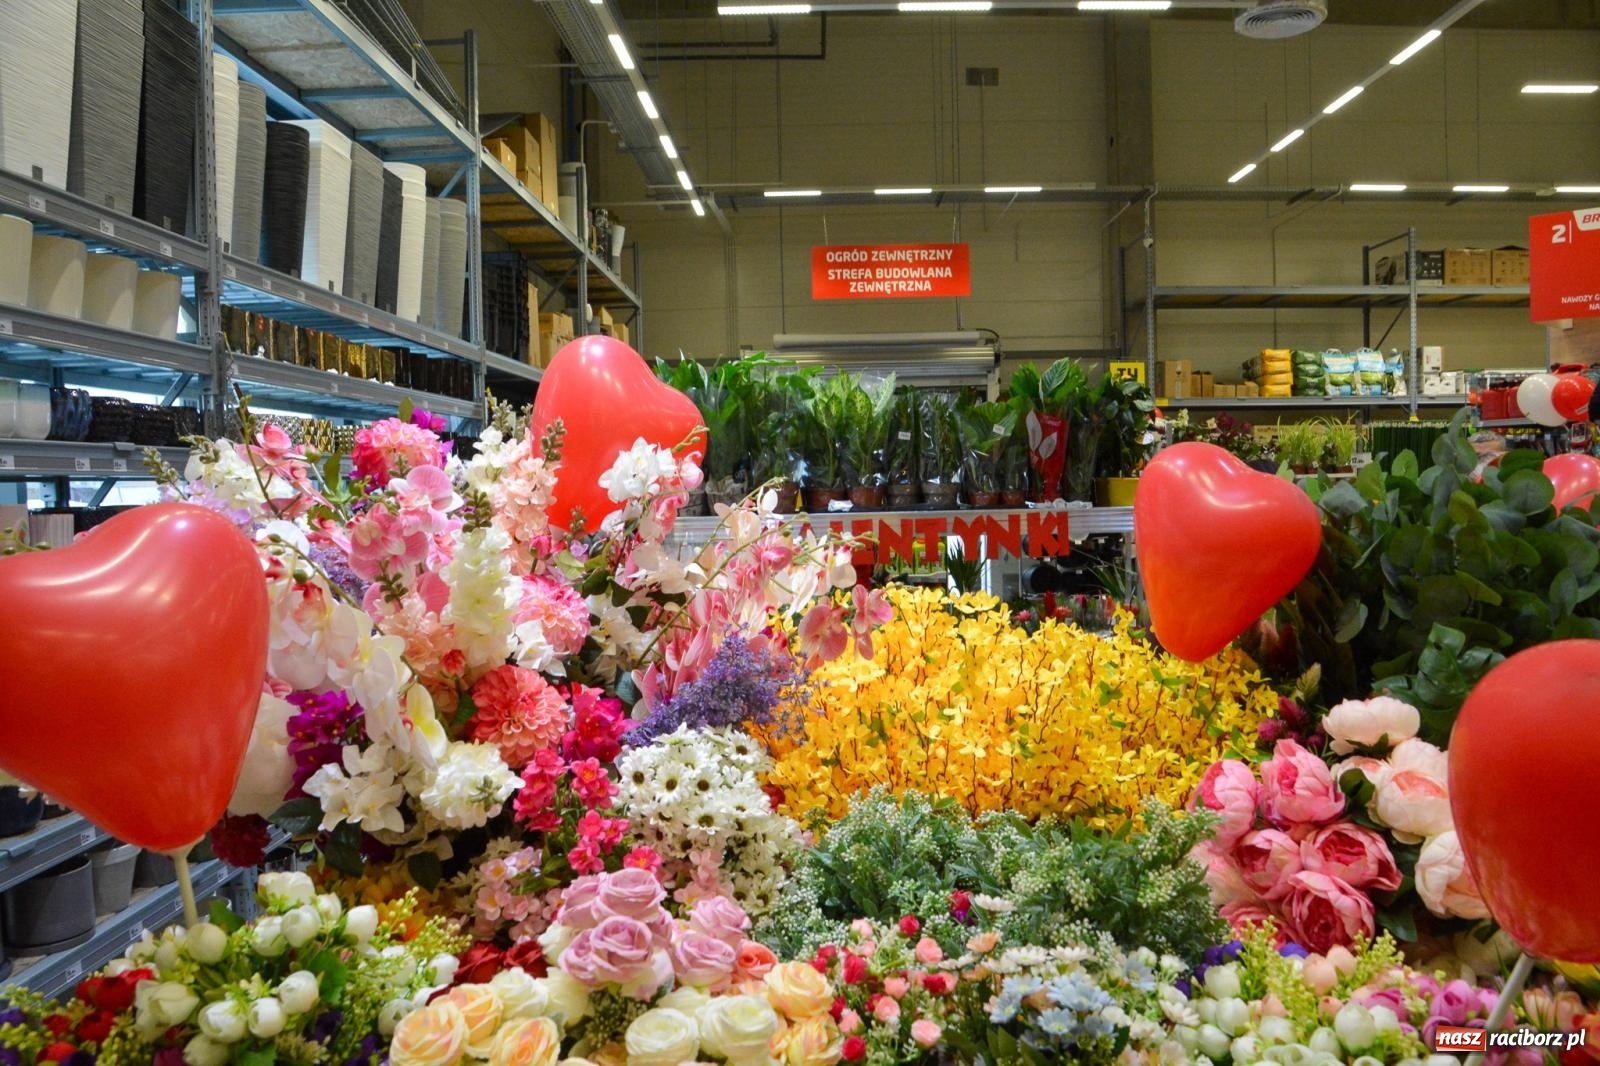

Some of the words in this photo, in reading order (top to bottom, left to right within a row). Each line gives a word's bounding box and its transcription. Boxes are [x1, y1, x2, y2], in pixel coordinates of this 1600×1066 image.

[1551, 224, 1566, 244] 2
[826, 249, 868, 262] OGRÓD
[871, 249, 953, 263] ZEWNĘTRZNY
[828, 268, 873, 281] STREFA
[876, 266, 953, 279] BUDOWLANA
[849, 280, 932, 294] ZEWNĘTRZNA
[800, 511, 1070, 566] ENTYNKI
